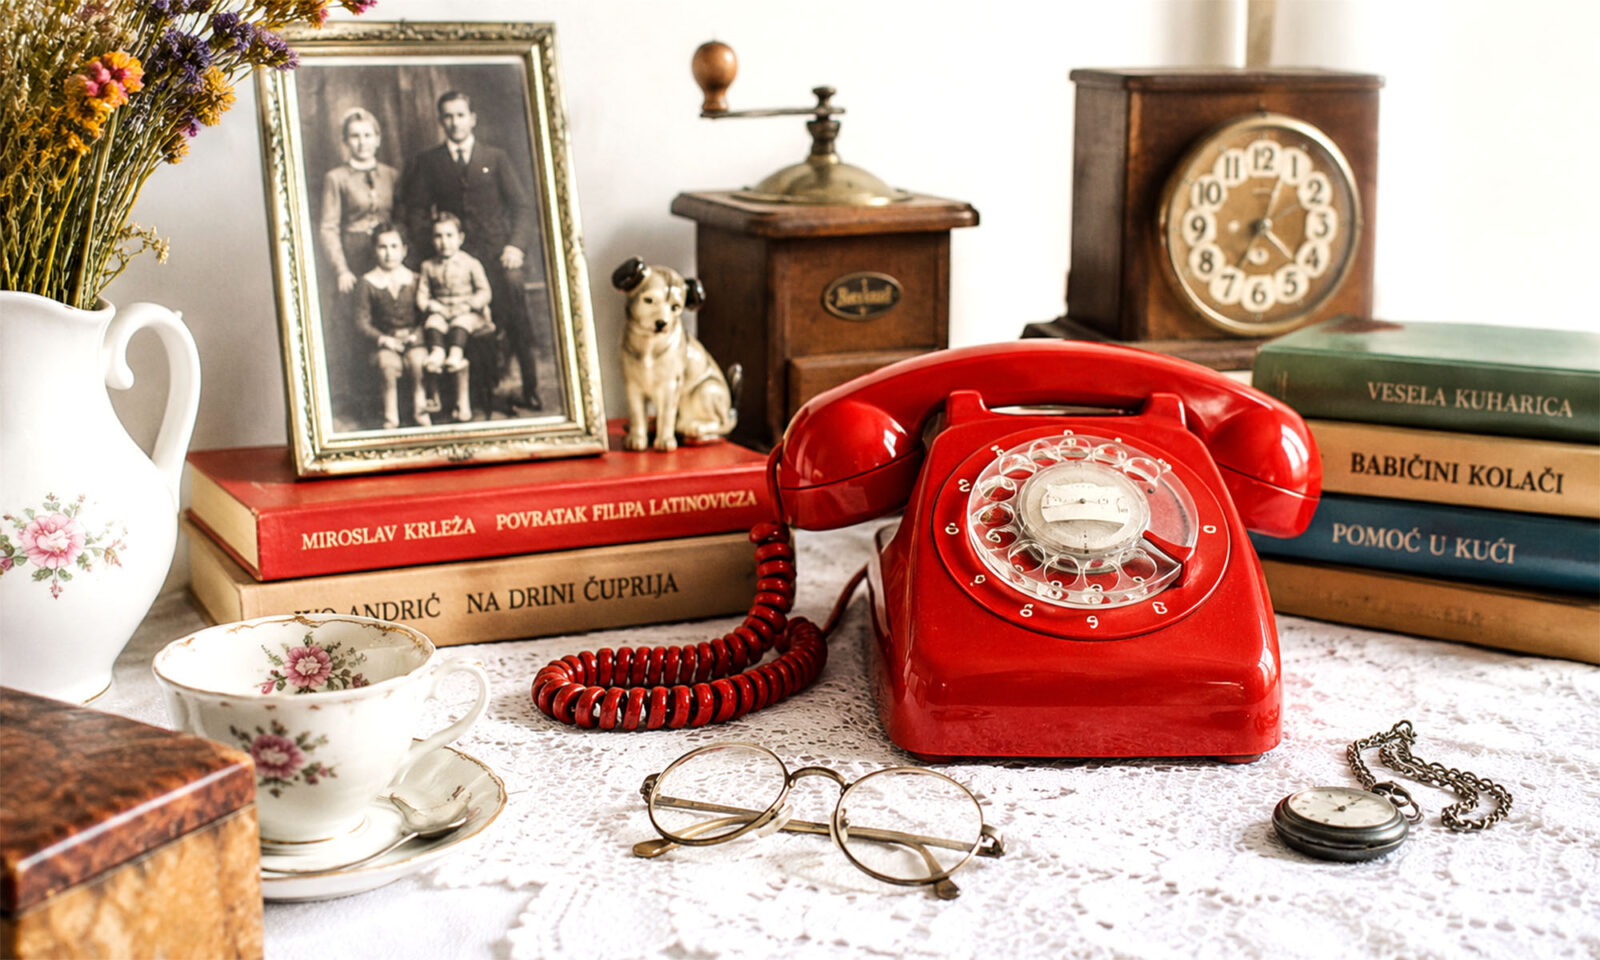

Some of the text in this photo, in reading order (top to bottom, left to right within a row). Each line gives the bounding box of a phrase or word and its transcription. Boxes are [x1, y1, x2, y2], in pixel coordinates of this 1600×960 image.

[1225, 156, 1240, 180] 11
[1253, 147, 1274, 171] 12
[1291, 156, 1298, 179] 1
[1198, 181, 1222, 205] 10
[1308, 180, 1323, 204] 2
[1191, 216, 1207, 241] 9
[1314, 213, 1329, 236] 3
[1200, 250, 1214, 273] 8
[1304, 247, 1320, 270] 4
[1221, 274, 1235, 298] 7
[1252, 281, 1266, 305] 6
[1283, 272, 1298, 295] 5
[1367, 381, 1574, 418] VESELA KUHARICA
[1350, 451, 1564, 495] BABIČINI KOLAČI
[301, 490, 758, 550] MIROSLAV KRLEŽA POVRATAK FILIPA LATINOVICZA
[1332, 522, 1516, 565] POMOĆ U KUĆI
[466, 592, 501, 614] NA
[508, 582, 576, 610] DRINI
[583, 573, 679, 602] ČUPRIJA
